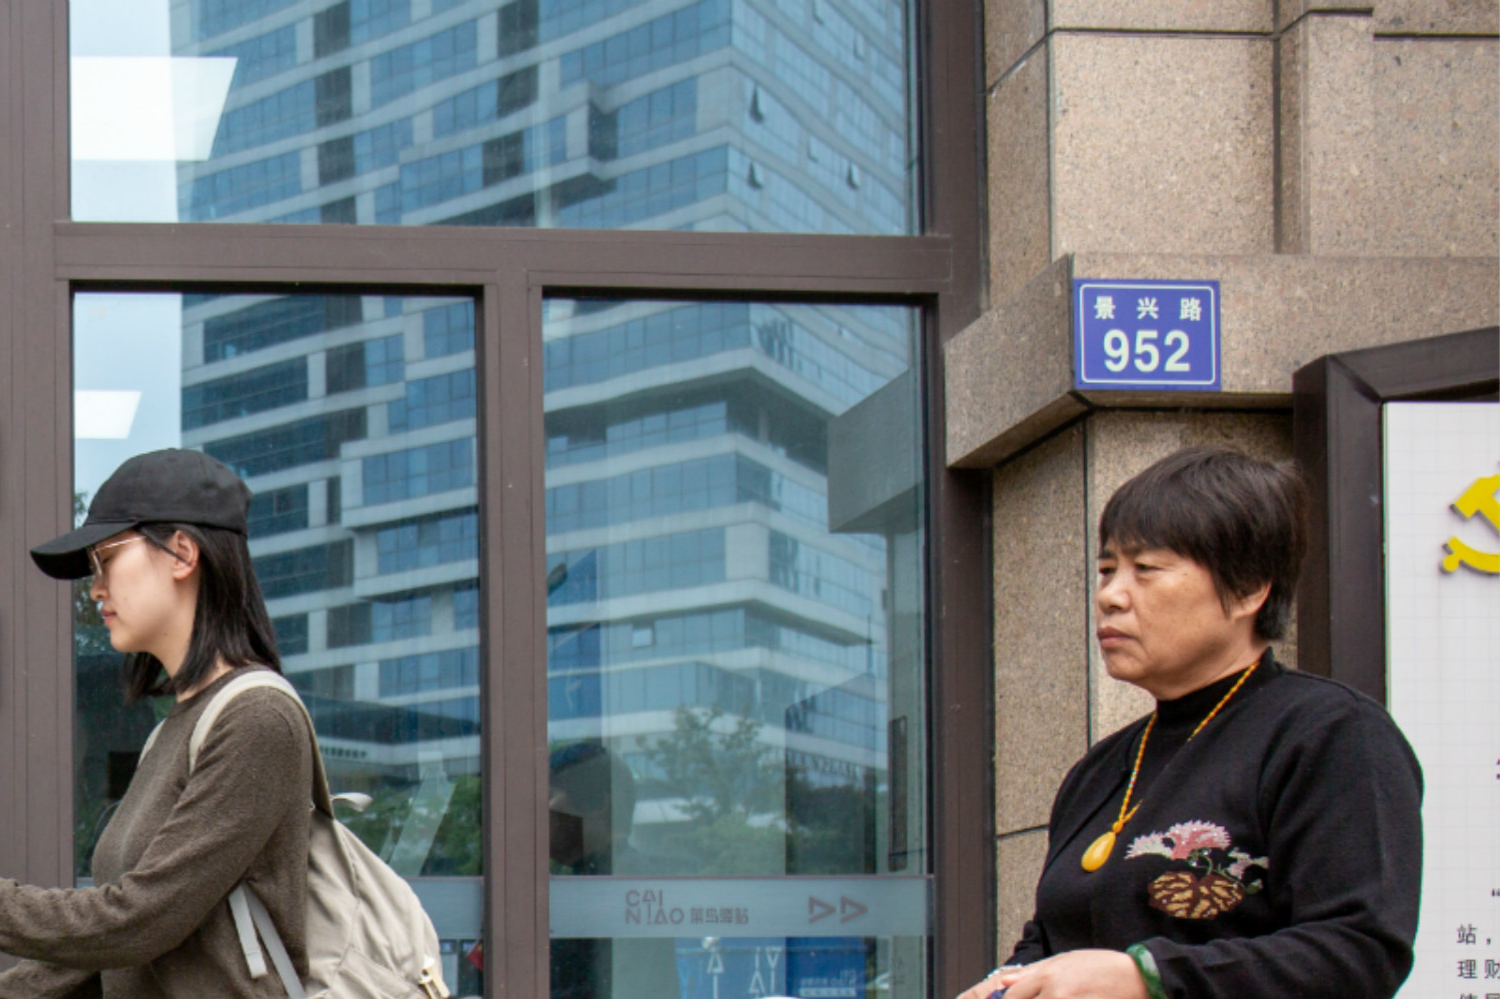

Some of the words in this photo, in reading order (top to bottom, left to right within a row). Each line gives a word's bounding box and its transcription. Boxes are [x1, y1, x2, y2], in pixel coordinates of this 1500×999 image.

[1094, 296, 1202, 321] 景兴路
[1103, 328, 1191, 373] 952
[625, 889, 663, 907] CAI
[690, 907, 749, 925] 菜鸟驿站
